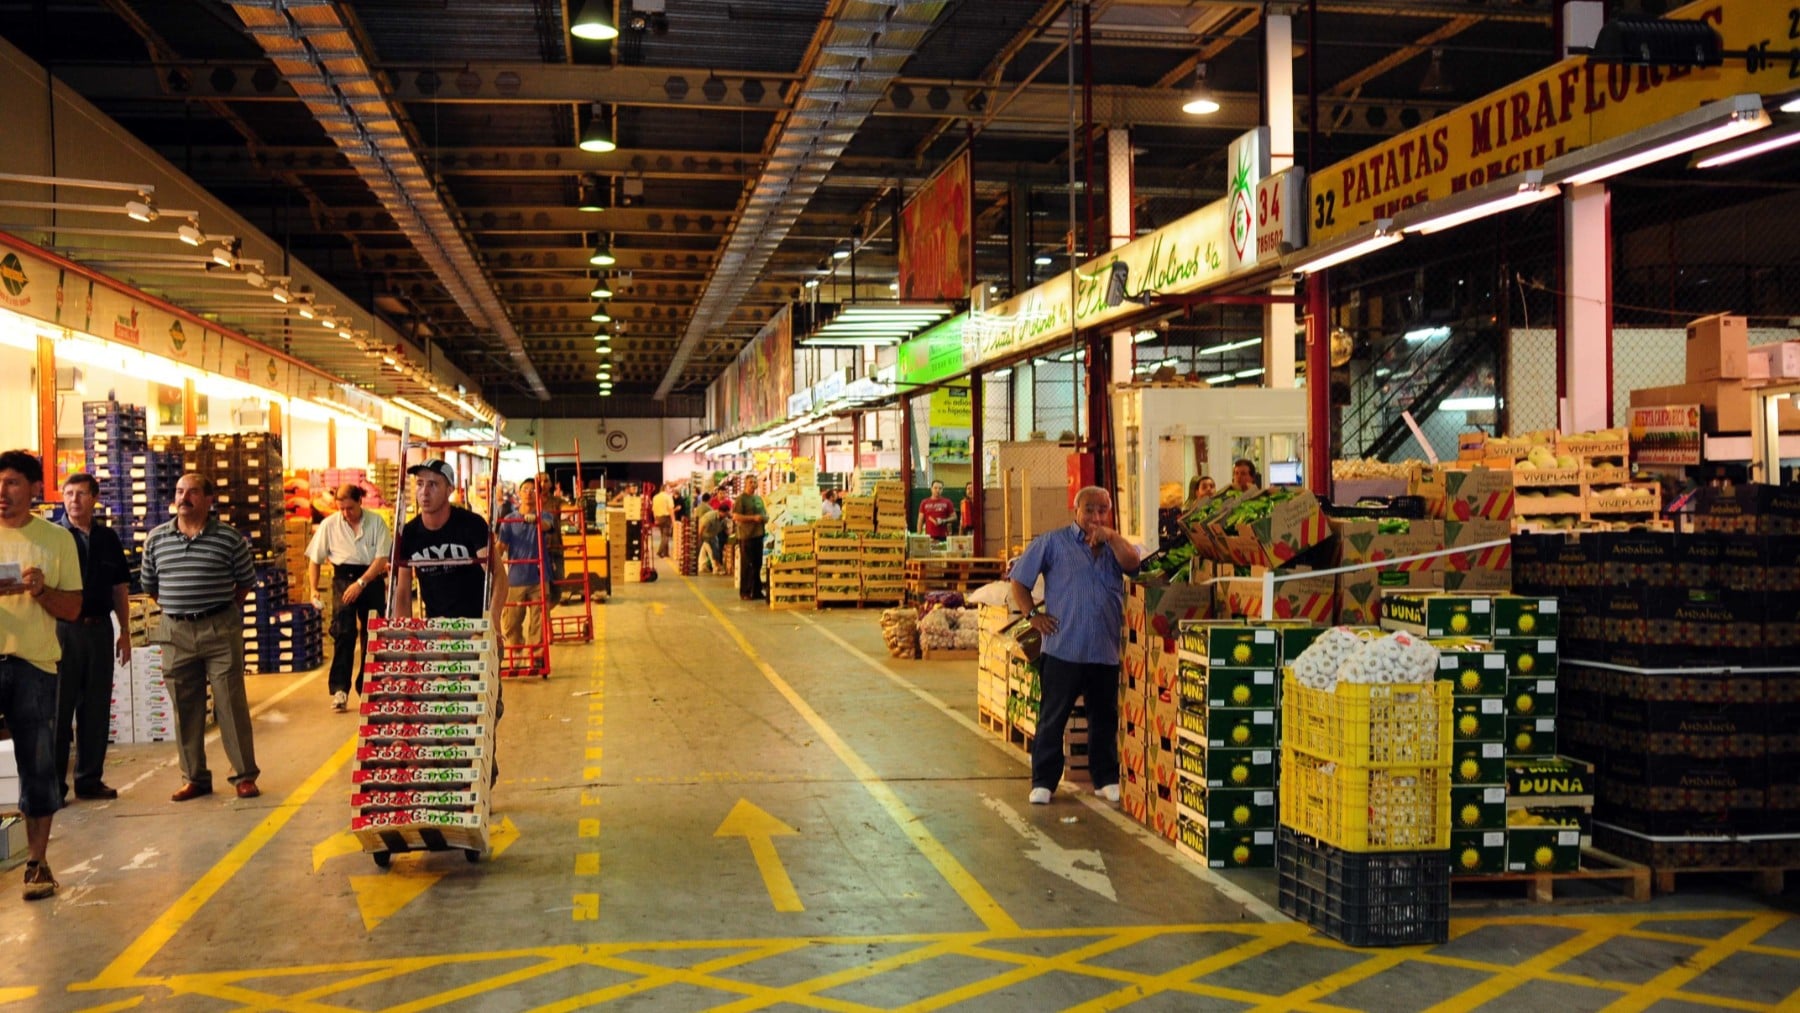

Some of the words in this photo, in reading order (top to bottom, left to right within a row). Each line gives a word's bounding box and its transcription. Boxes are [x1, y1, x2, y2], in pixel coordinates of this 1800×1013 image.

[1342, 126, 1449, 208] PATATAS
[1259, 182, 1280, 227] 34
[1314, 189, 1336, 230] 32
[1137, 234, 1200, 292] Molinos
[1493, 447, 1536, 456] VIVEPL
[1567, 443, 1625, 454] VIVEPLANT
[1523, 472, 1579, 482] VIVEPLANT
[1598, 499, 1655, 509] VIVEPLANT
[1391, 604, 1422, 623] DUNA
[1519, 777, 1584, 793] DUNA
